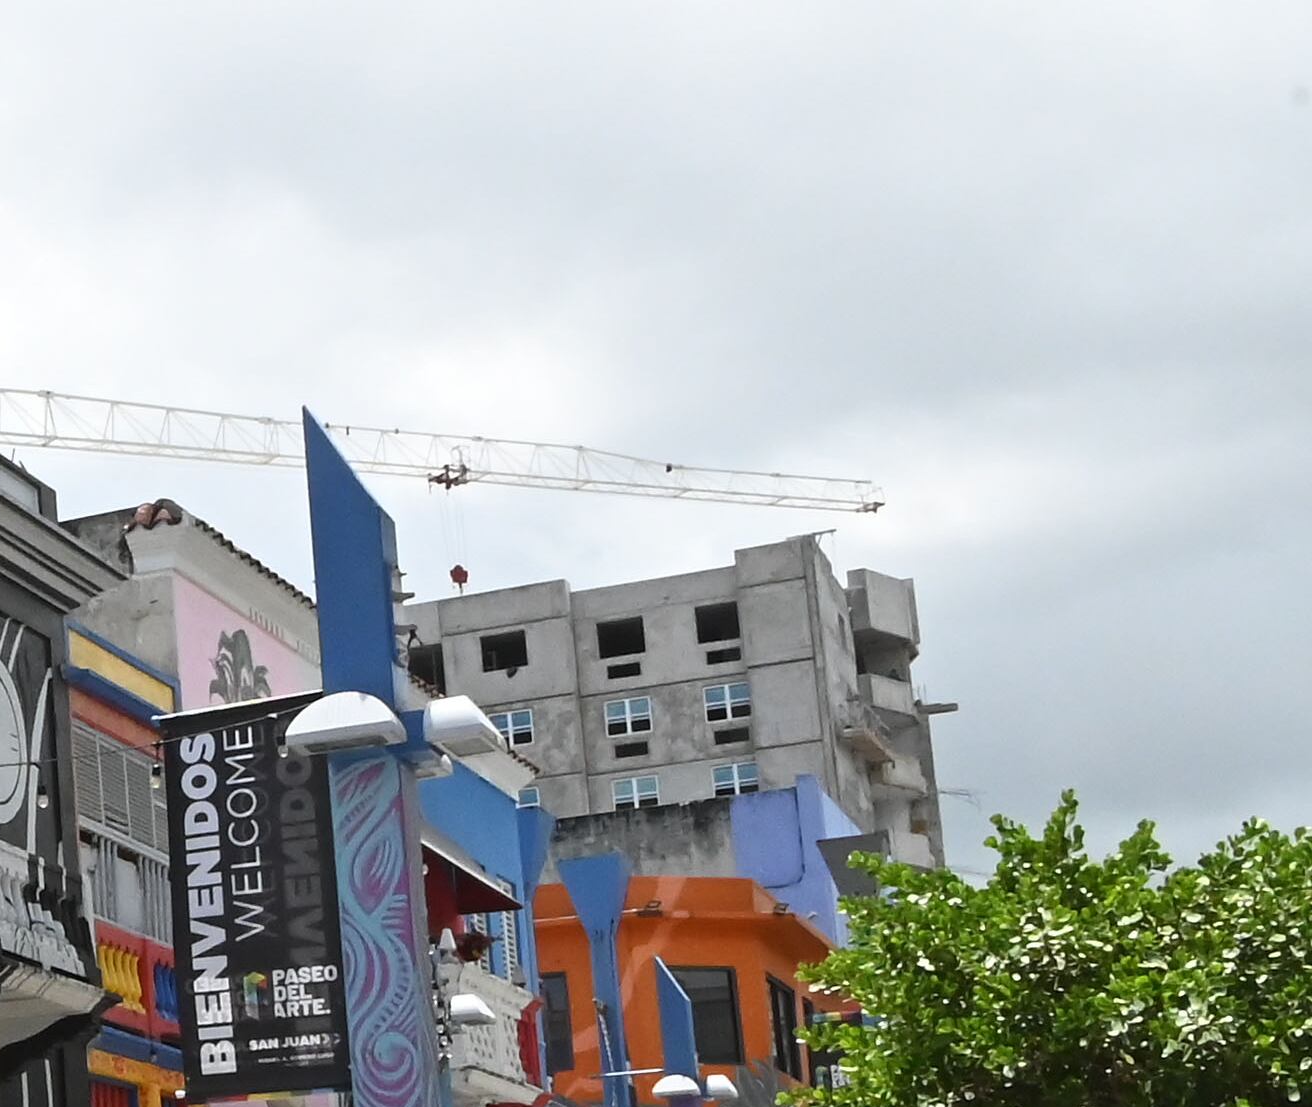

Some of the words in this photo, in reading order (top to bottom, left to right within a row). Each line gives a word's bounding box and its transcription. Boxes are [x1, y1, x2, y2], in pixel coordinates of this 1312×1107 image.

[223, 725, 265, 943] WELCOME
[179, 731, 237, 1076] BIENVENIDOS
[272, 965, 338, 986] PASEO
[274, 984, 313, 1002] DEL
[274, 998, 331, 1018] ARTE.
[248, 1038, 279, 1051] SAN
[281, 1034, 321, 1048] JUAN
